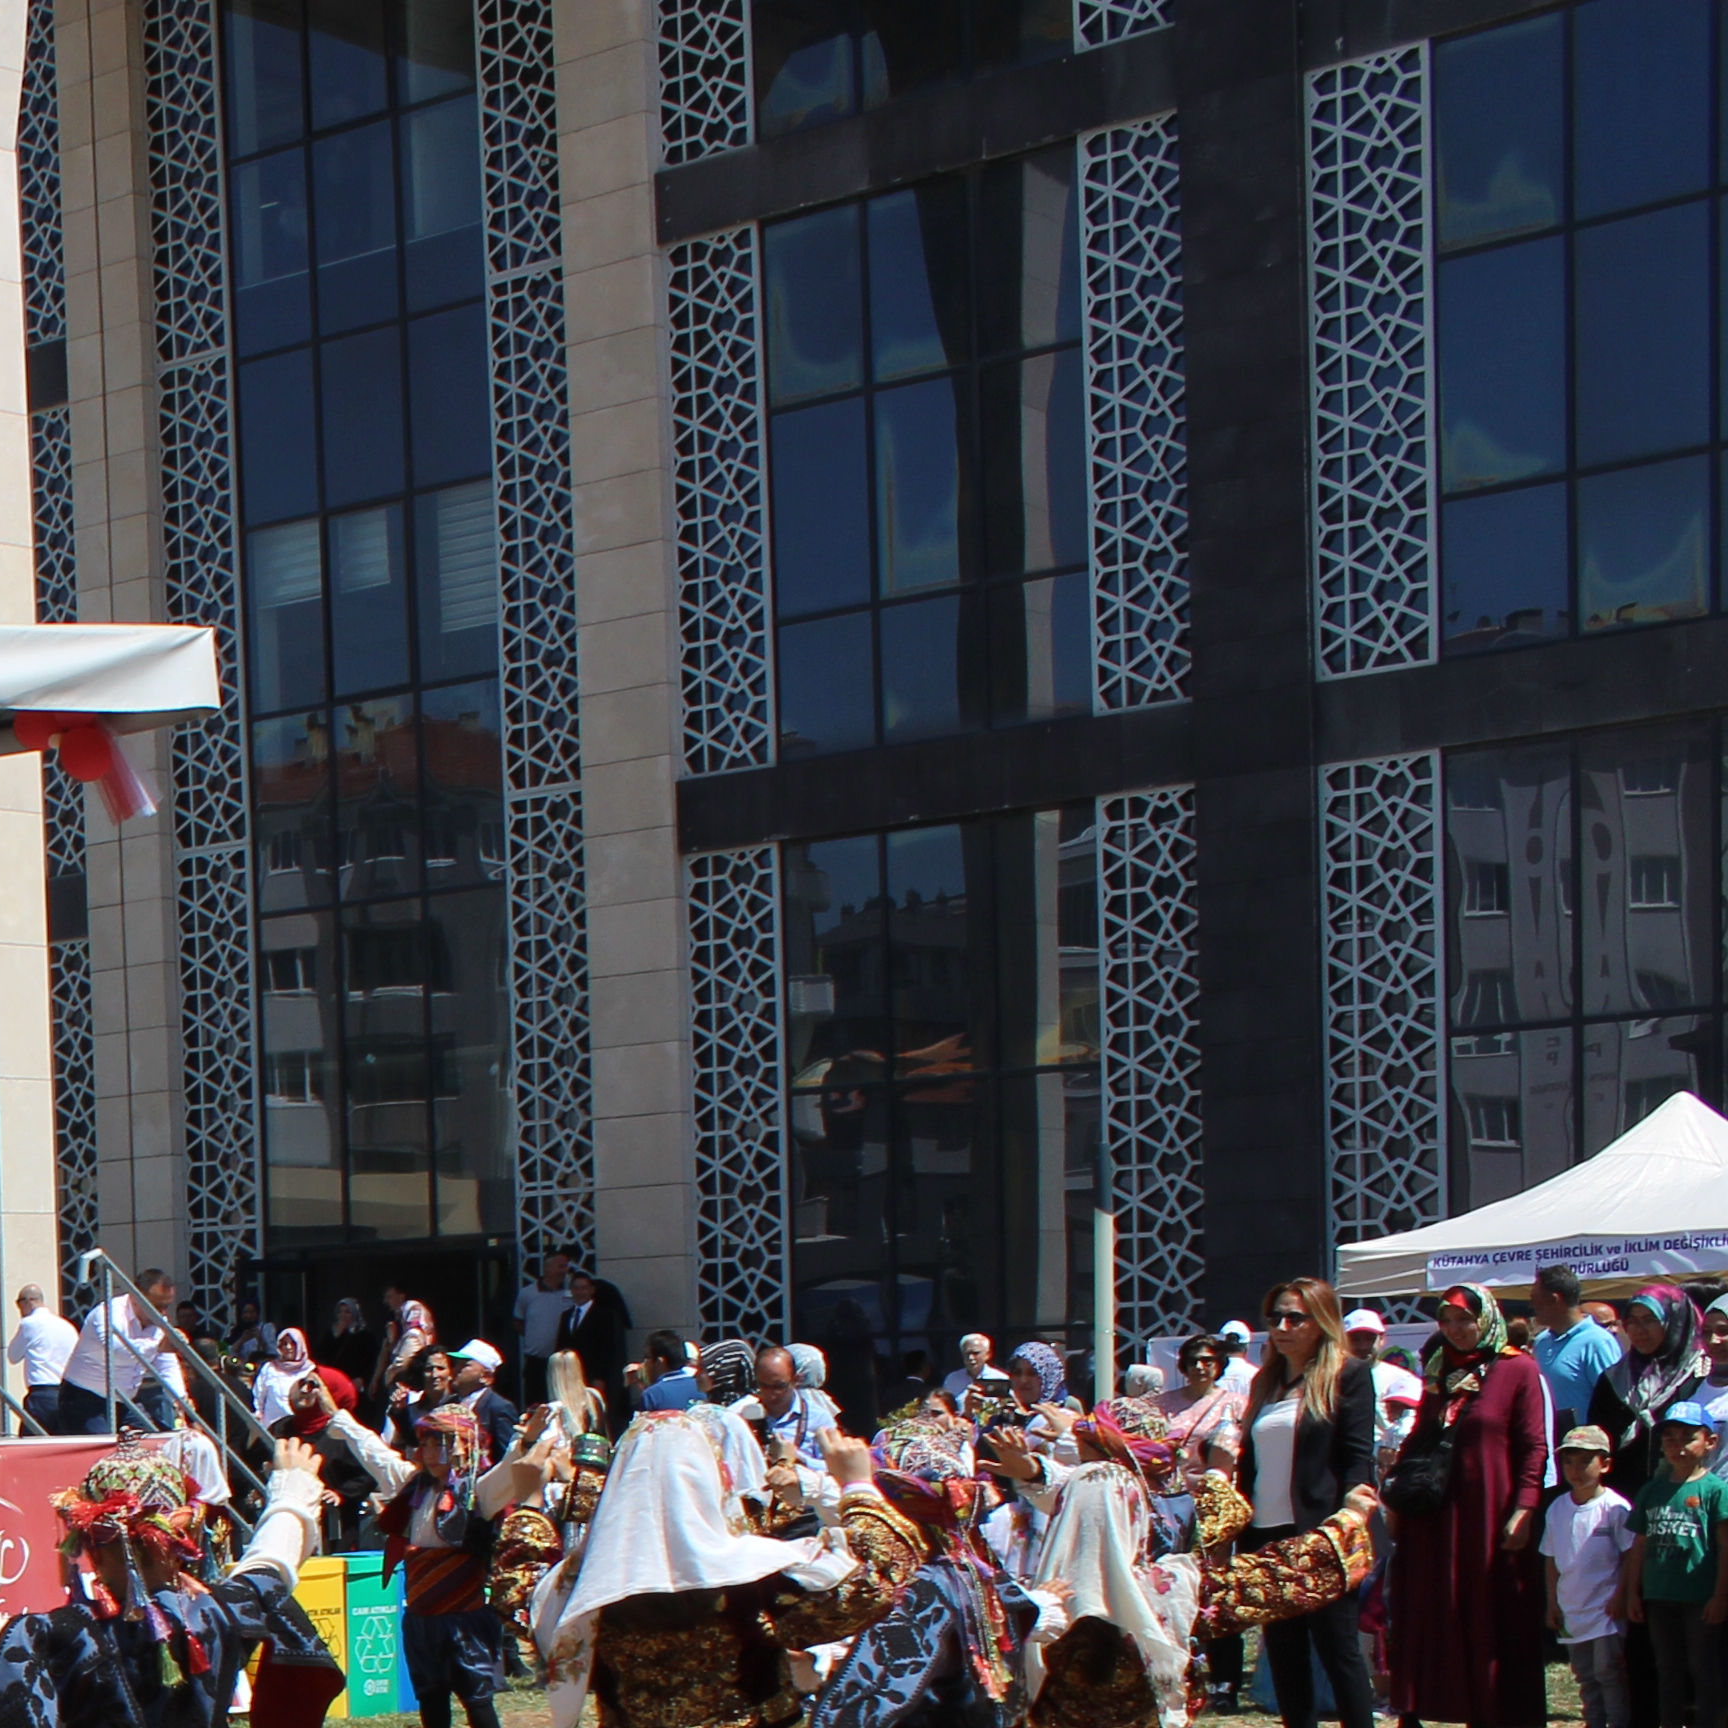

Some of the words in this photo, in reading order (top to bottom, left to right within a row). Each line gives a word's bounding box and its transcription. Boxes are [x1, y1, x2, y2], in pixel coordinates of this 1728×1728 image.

[1433, 1252, 1490, 1268] KÜTAHYA
[1492, 1249, 1532, 1266] ÇEVRE
[1535, 1242, 1604, 1263] ŞEHİRCİLİK
[1606, 1245, 1622, 1255] ve
[1624, 1238, 1660, 1254] İKLİM
[1569, 1258, 1630, 1275] DÜRLÜĞÜ
